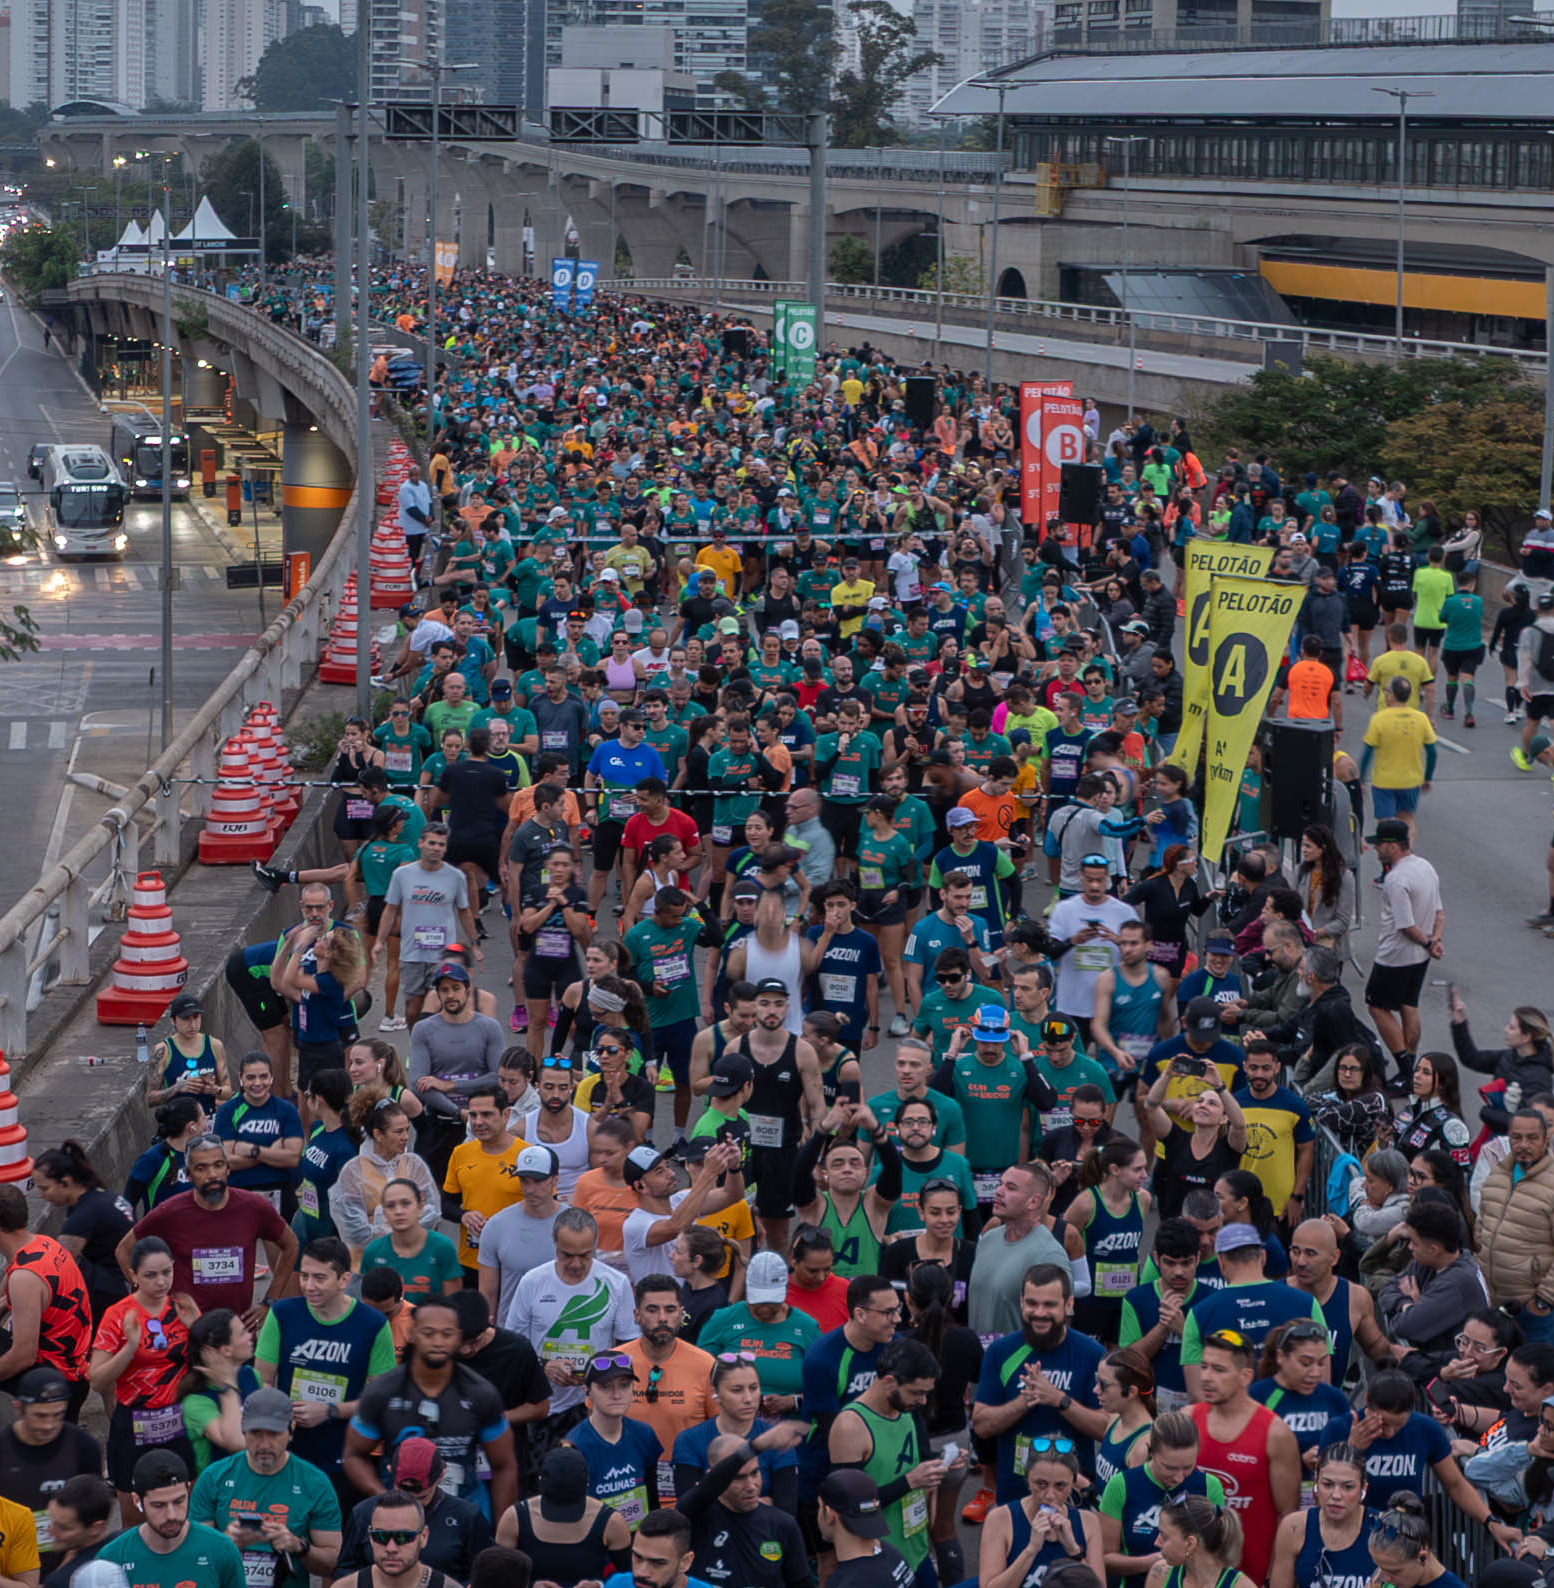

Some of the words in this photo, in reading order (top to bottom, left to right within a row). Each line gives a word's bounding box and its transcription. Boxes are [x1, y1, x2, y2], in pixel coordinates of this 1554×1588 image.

[796, 327, 808, 343] C
[1060, 433, 1078, 460] B
[1190, 551, 1261, 576] PELOTÃO
[1217, 590, 1293, 616] PELOTÃO
[1217, 642, 1247, 698] A
[824, 949, 861, 963] AZON
[238, 1119, 281, 1135] AZON
[305, 1145, 329, 1169] AZON
[1095, 1231, 1141, 1252] AZON
[208, 1259, 235, 1272] 3734
[290, 1338, 351, 1364] AZON
[307, 1385, 336, 1399] 6106
[150, 1418, 179, 1432] 5379
[1365, 1454, 1417, 1478] AZON
[596, 1477, 636, 1496] COLINAS
[230, 1498, 257, 1511] RUN
